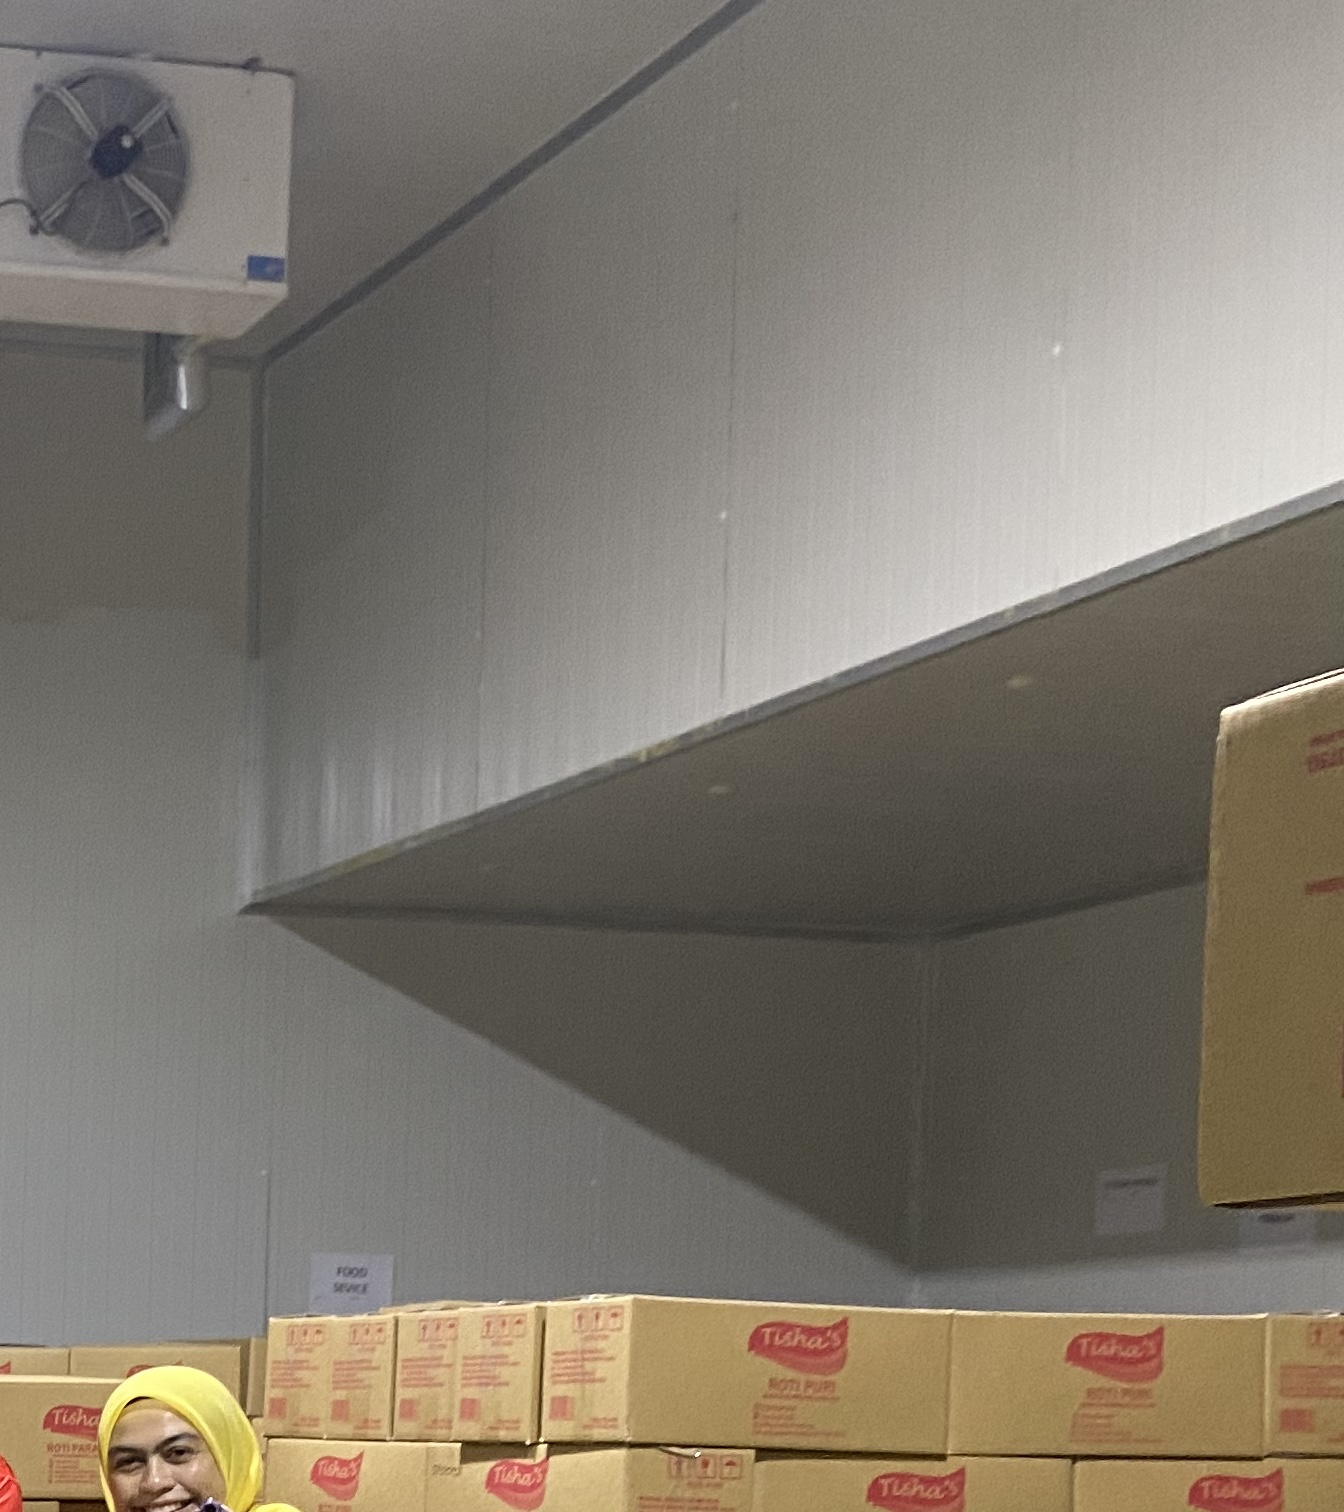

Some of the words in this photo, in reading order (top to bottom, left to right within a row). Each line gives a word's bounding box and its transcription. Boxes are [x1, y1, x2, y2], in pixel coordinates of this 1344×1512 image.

[759, 1326, 844, 1350] Tisha's
[52, 1407, 101, 1427] Tisha
[493, 1465, 544, 1487] Tisha's
[878, 1476, 960, 1499] Tisha's
